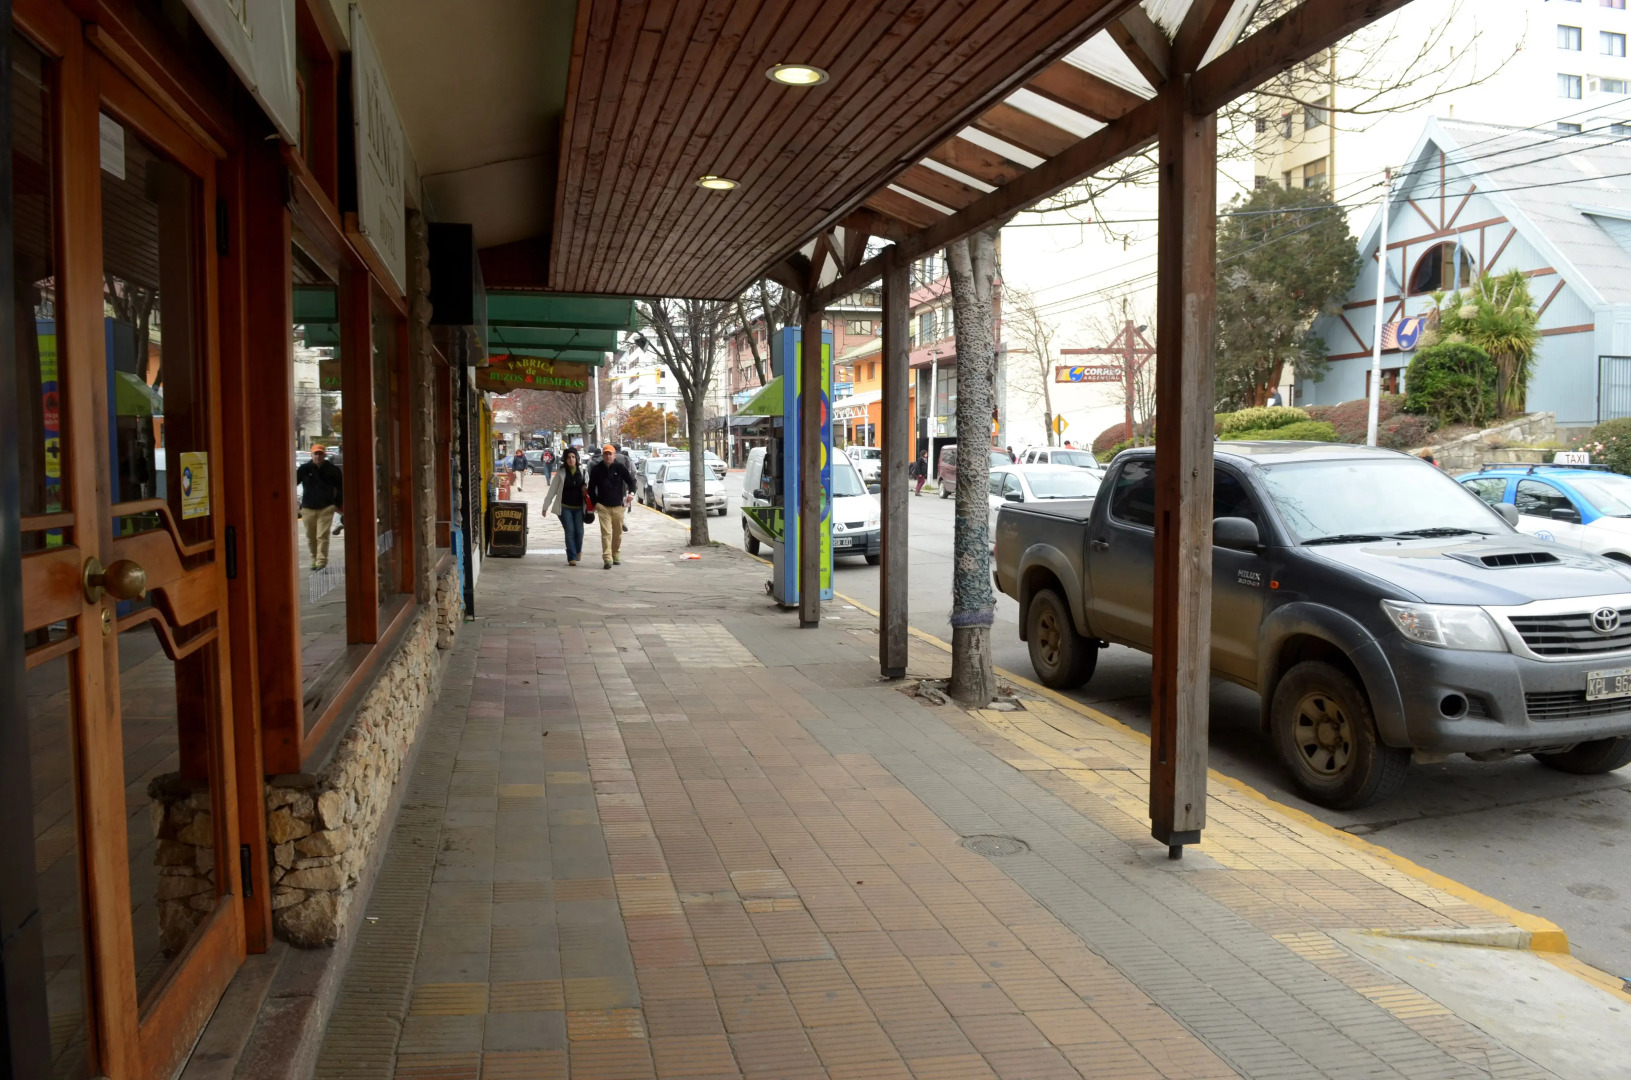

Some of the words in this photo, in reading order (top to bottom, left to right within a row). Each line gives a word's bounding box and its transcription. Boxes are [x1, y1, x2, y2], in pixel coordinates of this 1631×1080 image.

[508, 359, 554, 374] FABRICA
[1084, 368, 1121, 376] CORREO
[490, 372, 523, 382] BUZOS
[525, 375, 533, 383] &
[536, 377, 584, 387] REMERAS
[1565, 454, 1585, 463] TAXI
[1537, 533, 1550, 541] TAXI
[1589, 678, 1609, 695] KPL
